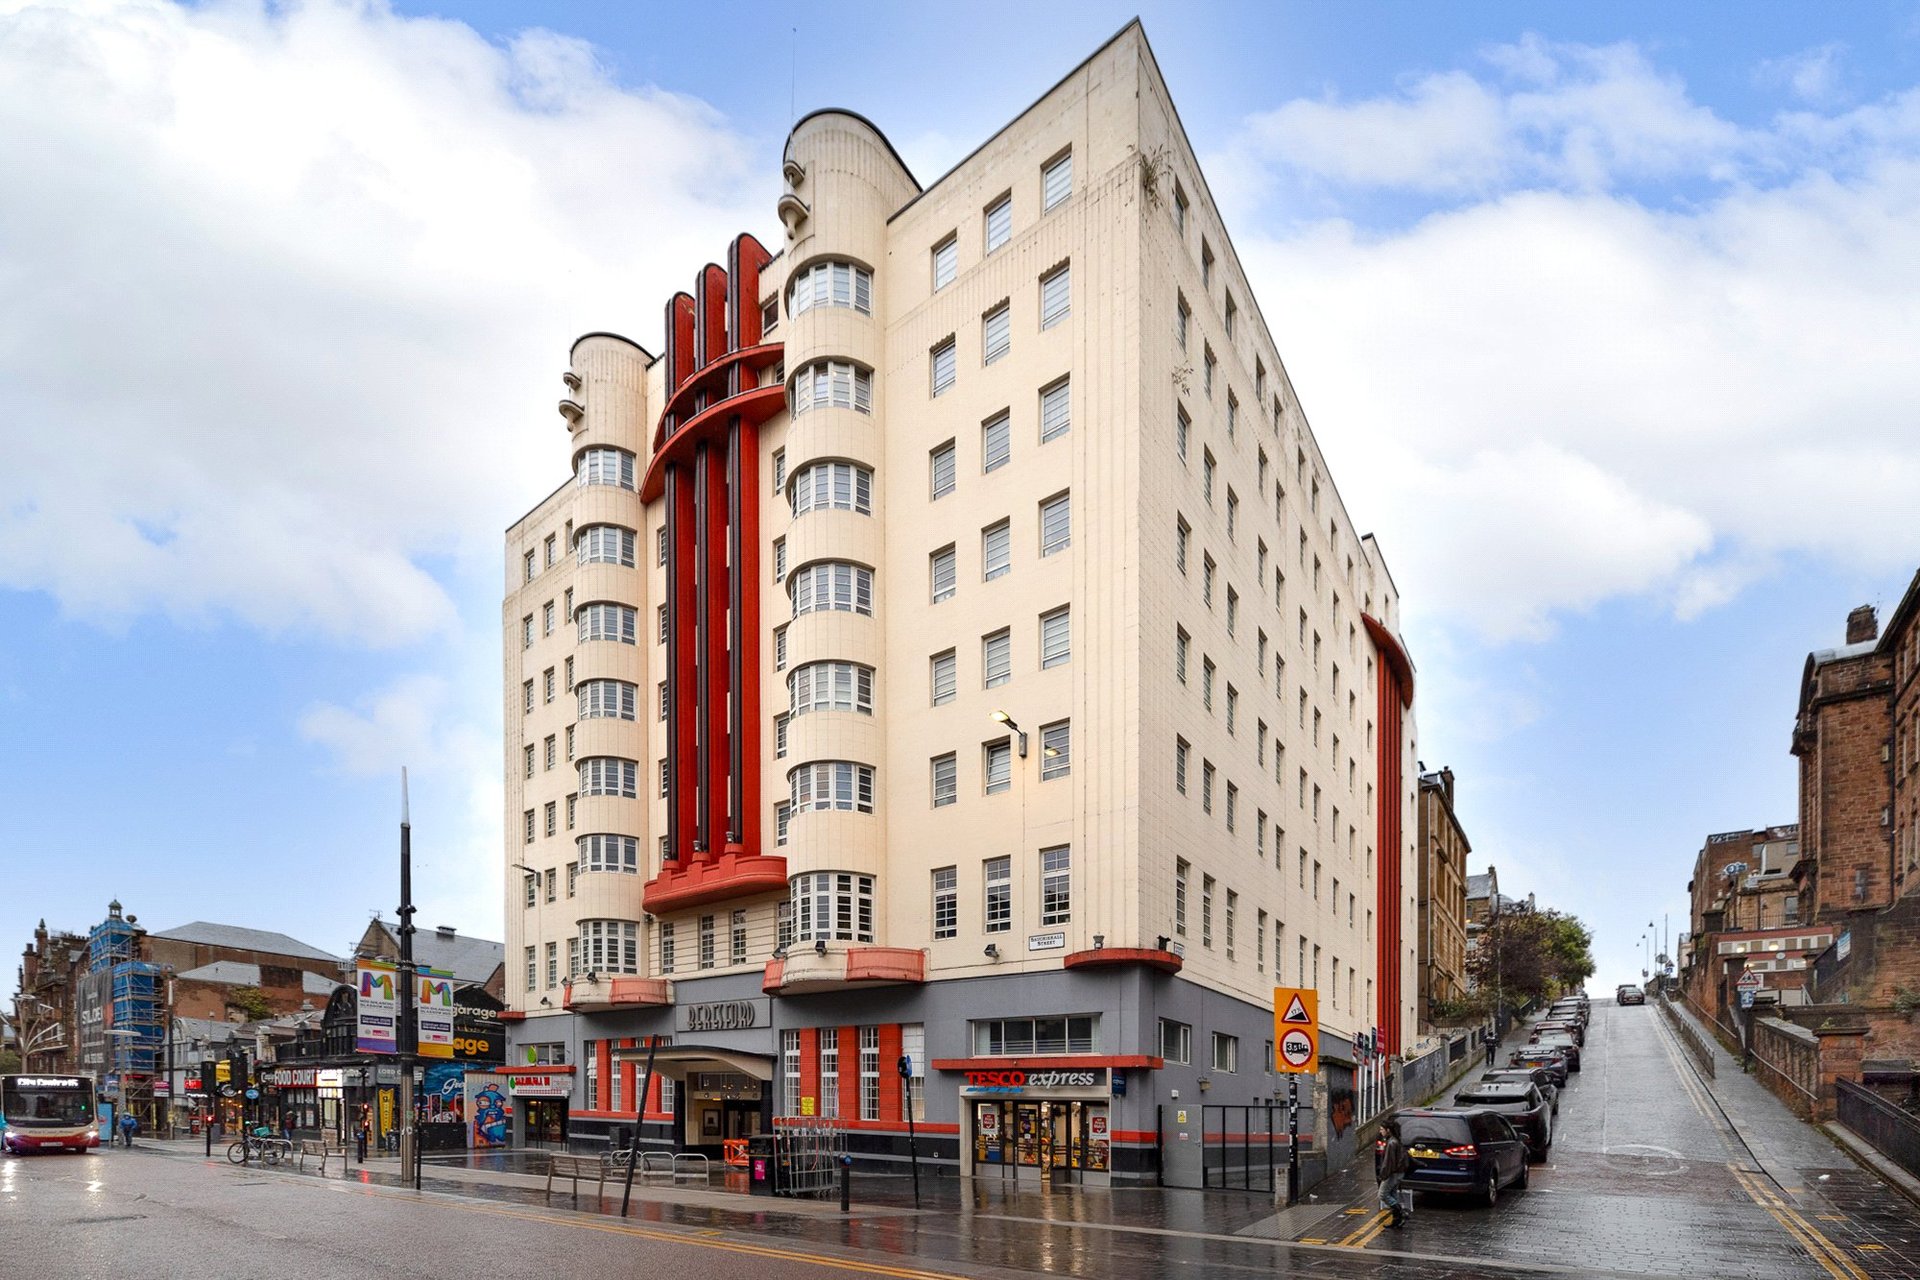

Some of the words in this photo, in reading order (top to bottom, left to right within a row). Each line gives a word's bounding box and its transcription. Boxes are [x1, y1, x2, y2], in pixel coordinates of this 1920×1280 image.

[687, 1001, 756, 1031] BERESFORD
[274, 1069, 292, 1086] FOOD
[292, 1069, 315, 1086] COURT
[964, 1071, 1025, 1087] TESCO
[1028, 1071, 1095, 1089] express
